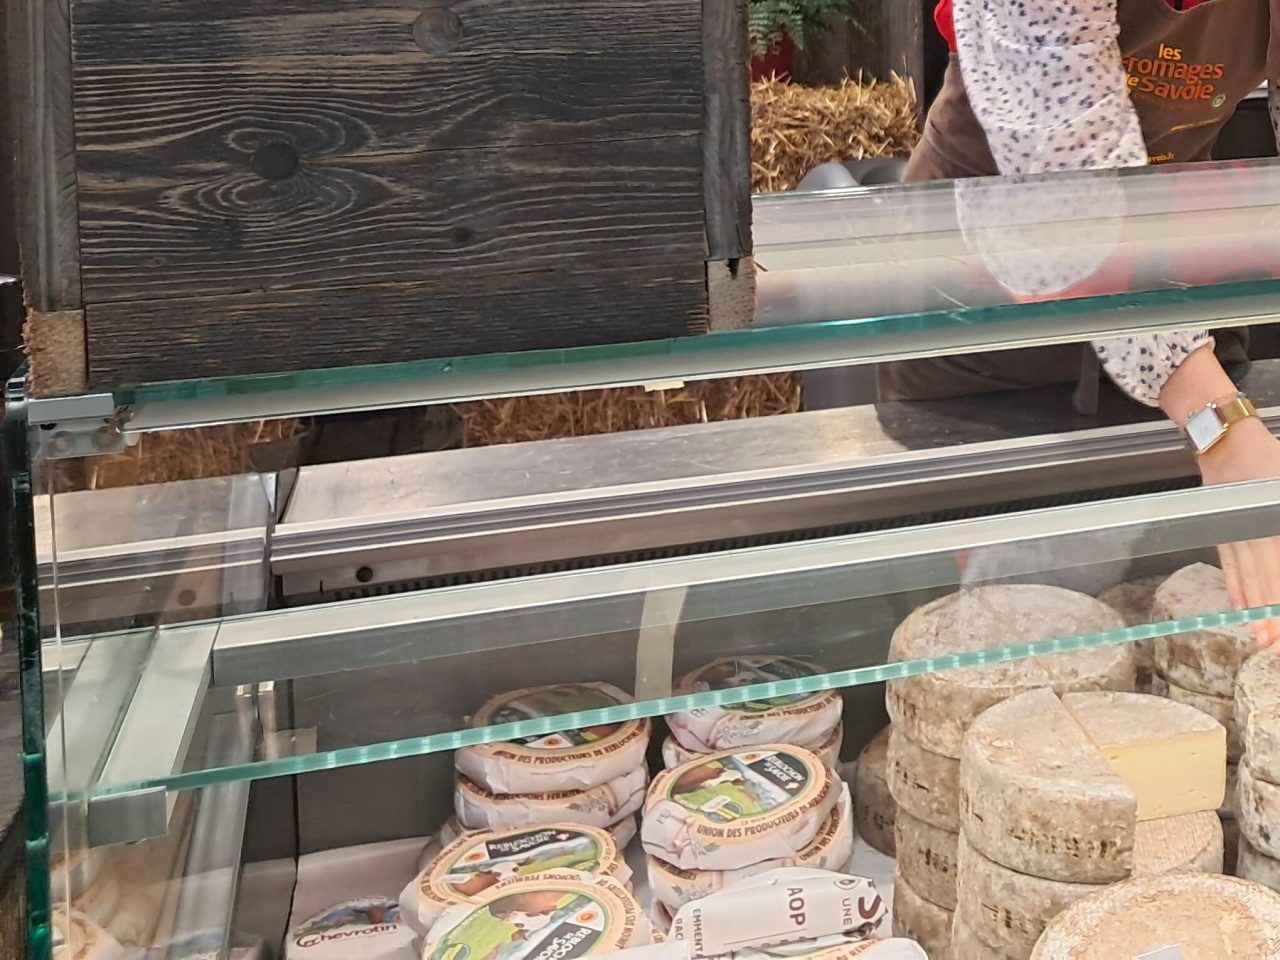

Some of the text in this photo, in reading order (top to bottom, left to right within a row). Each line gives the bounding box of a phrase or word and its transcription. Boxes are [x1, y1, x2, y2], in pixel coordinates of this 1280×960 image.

[1159, 43, 1183, 60] les
[517, 754, 531, 764] DES
[535, 751, 592, 764] PRODUCTEURS
[697, 825, 725, 838] UNION
[726, 827, 742, 838] DES
[744, 809, 800, 836] PRODUCTEURS
[488, 829, 557, 851] REBLOCHON
[787, 887, 806, 926] AOP
[842, 898, 852, 926] UNE
[295, 923, 398, 947] Chevrotin
